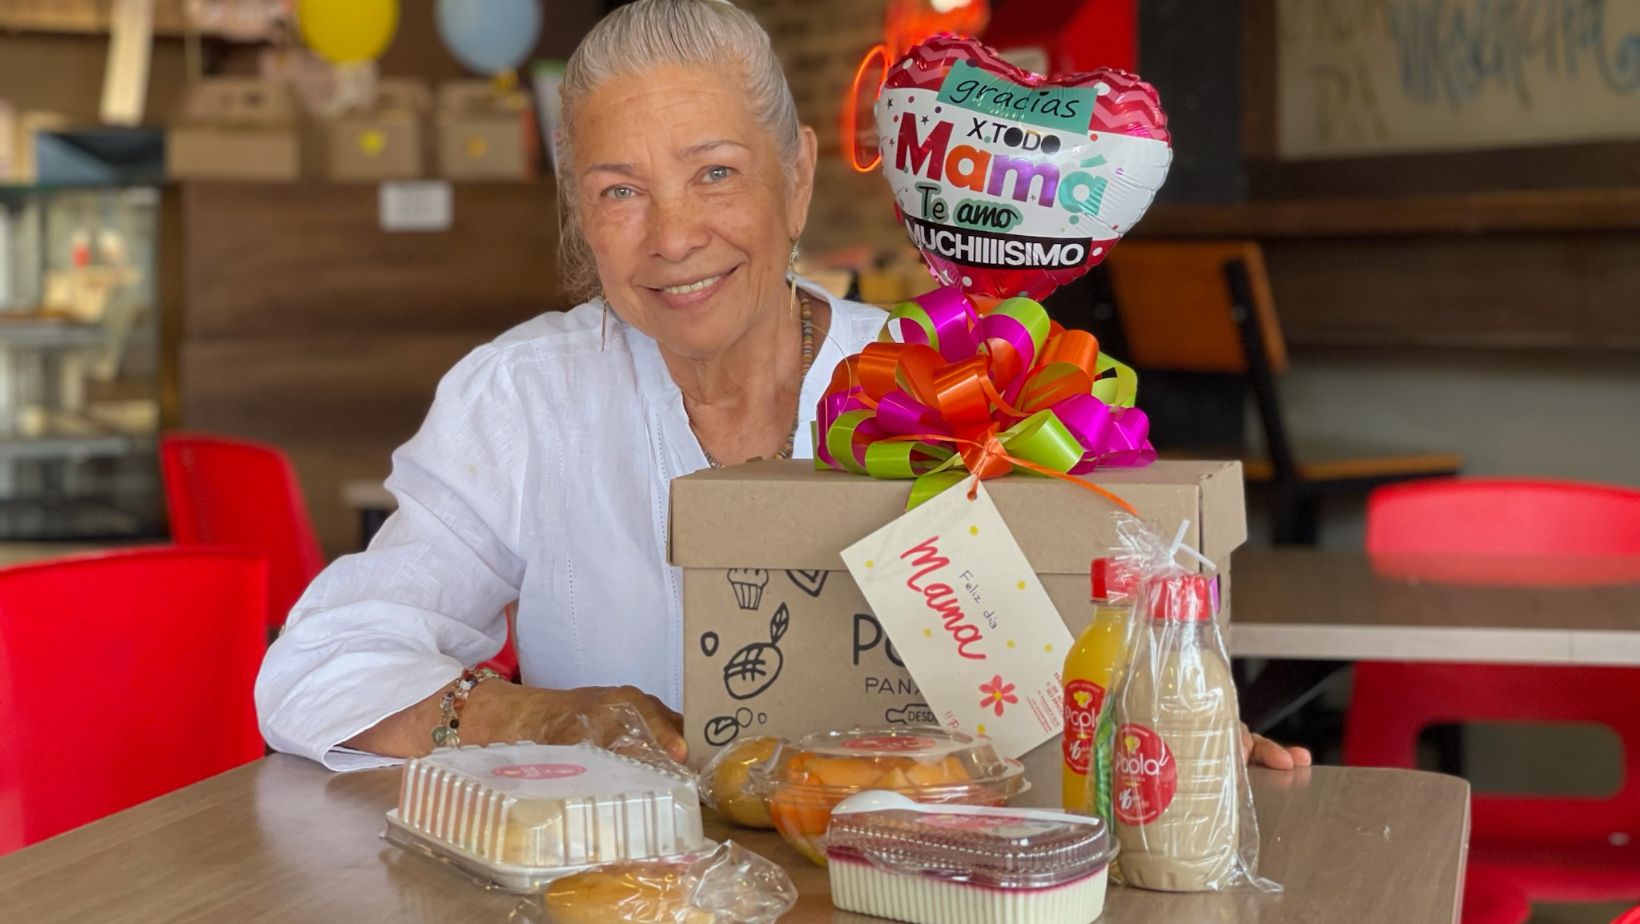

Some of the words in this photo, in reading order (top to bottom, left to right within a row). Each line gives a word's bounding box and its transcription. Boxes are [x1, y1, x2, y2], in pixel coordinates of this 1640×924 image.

[949, 78, 1080, 118] gracias
[895, 111, 1108, 216] Mamá
[917, 185, 946, 220] Te
[957, 201, 1018, 228] amo
[959, 569, 982, 605] Feliz
